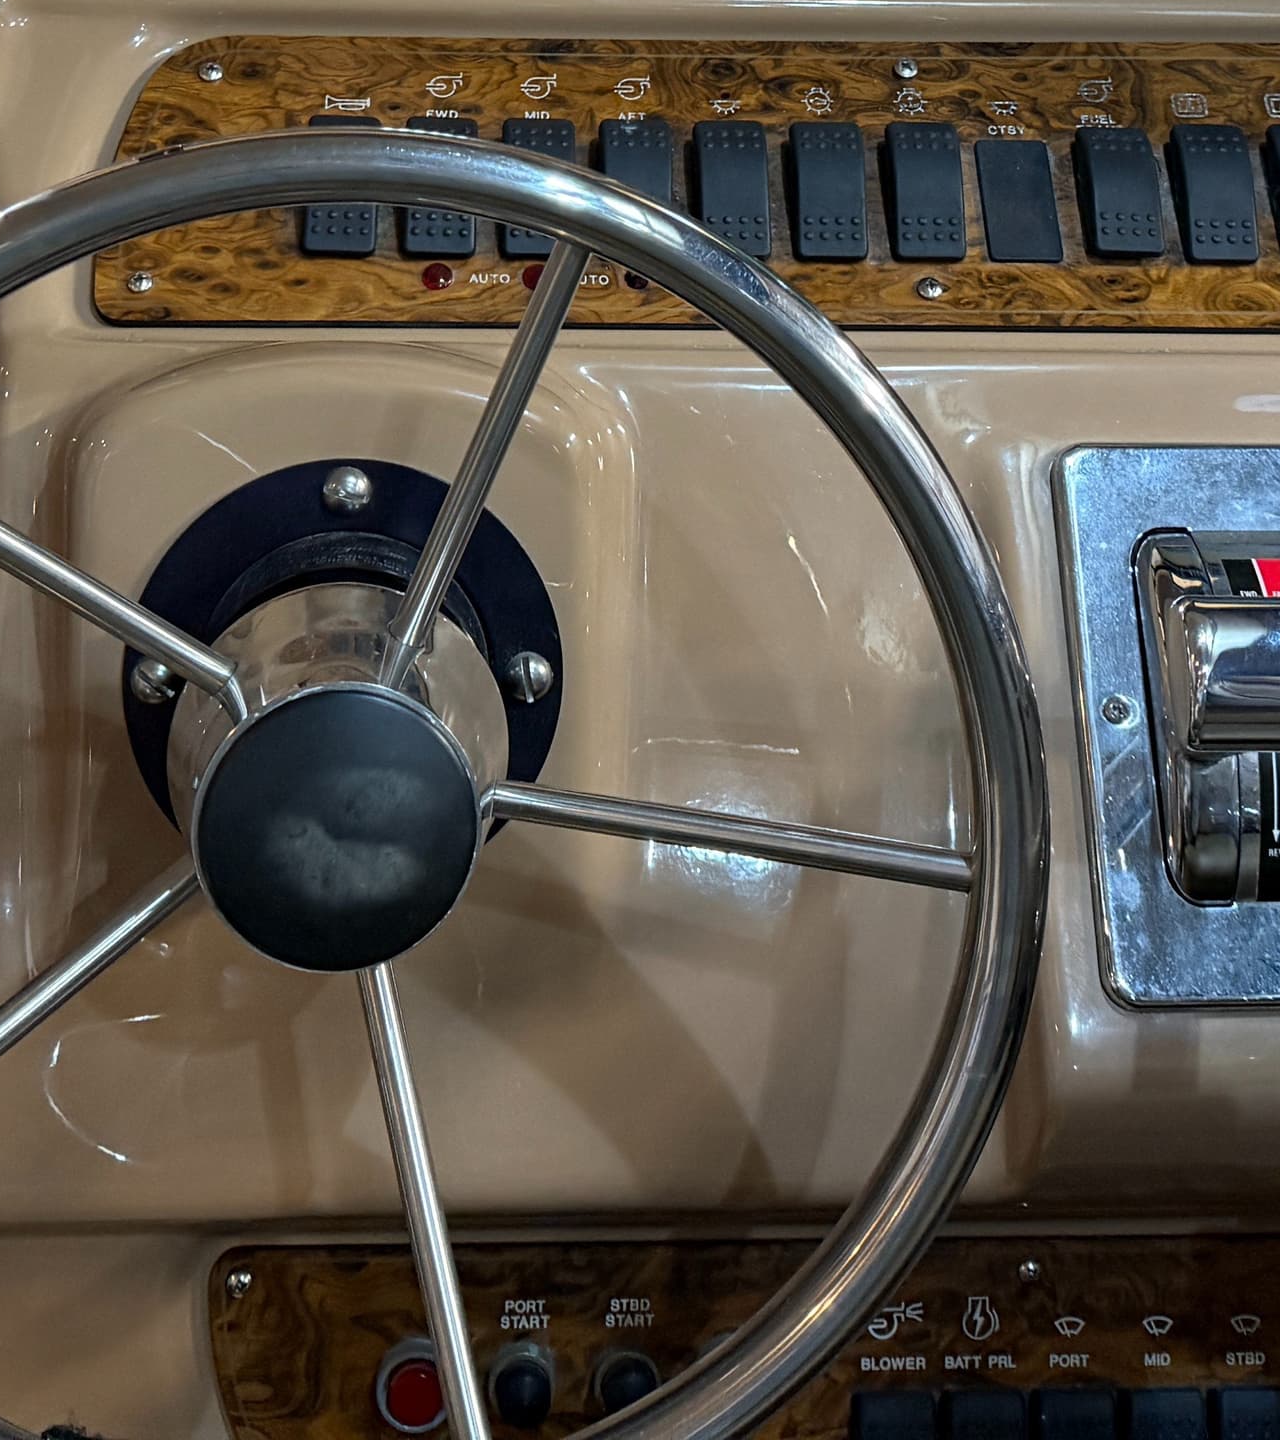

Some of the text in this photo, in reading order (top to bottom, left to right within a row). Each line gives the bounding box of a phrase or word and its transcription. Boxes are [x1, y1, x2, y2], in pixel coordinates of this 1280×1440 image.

[426, 110, 459, 120] FWD
[524, 111, 551, 120] MID
[1080, 114, 1117, 125] FUEL
[470, 273, 511, 285] AUTO
[505, 1299, 546, 1313] PORT
[610, 1298, 650, 1312] STBD
[500, 1314, 551, 1329] START
[605, 1313, 655, 1328] START
[861, 1356, 926, 1371] BLOWER
[944, 1355, 1017, 1369] BATT PRL
[1049, 1353, 1089, 1368] PORT
[1144, 1352, 1172, 1366] MID
[1226, 1352, 1267, 1366] STBD
